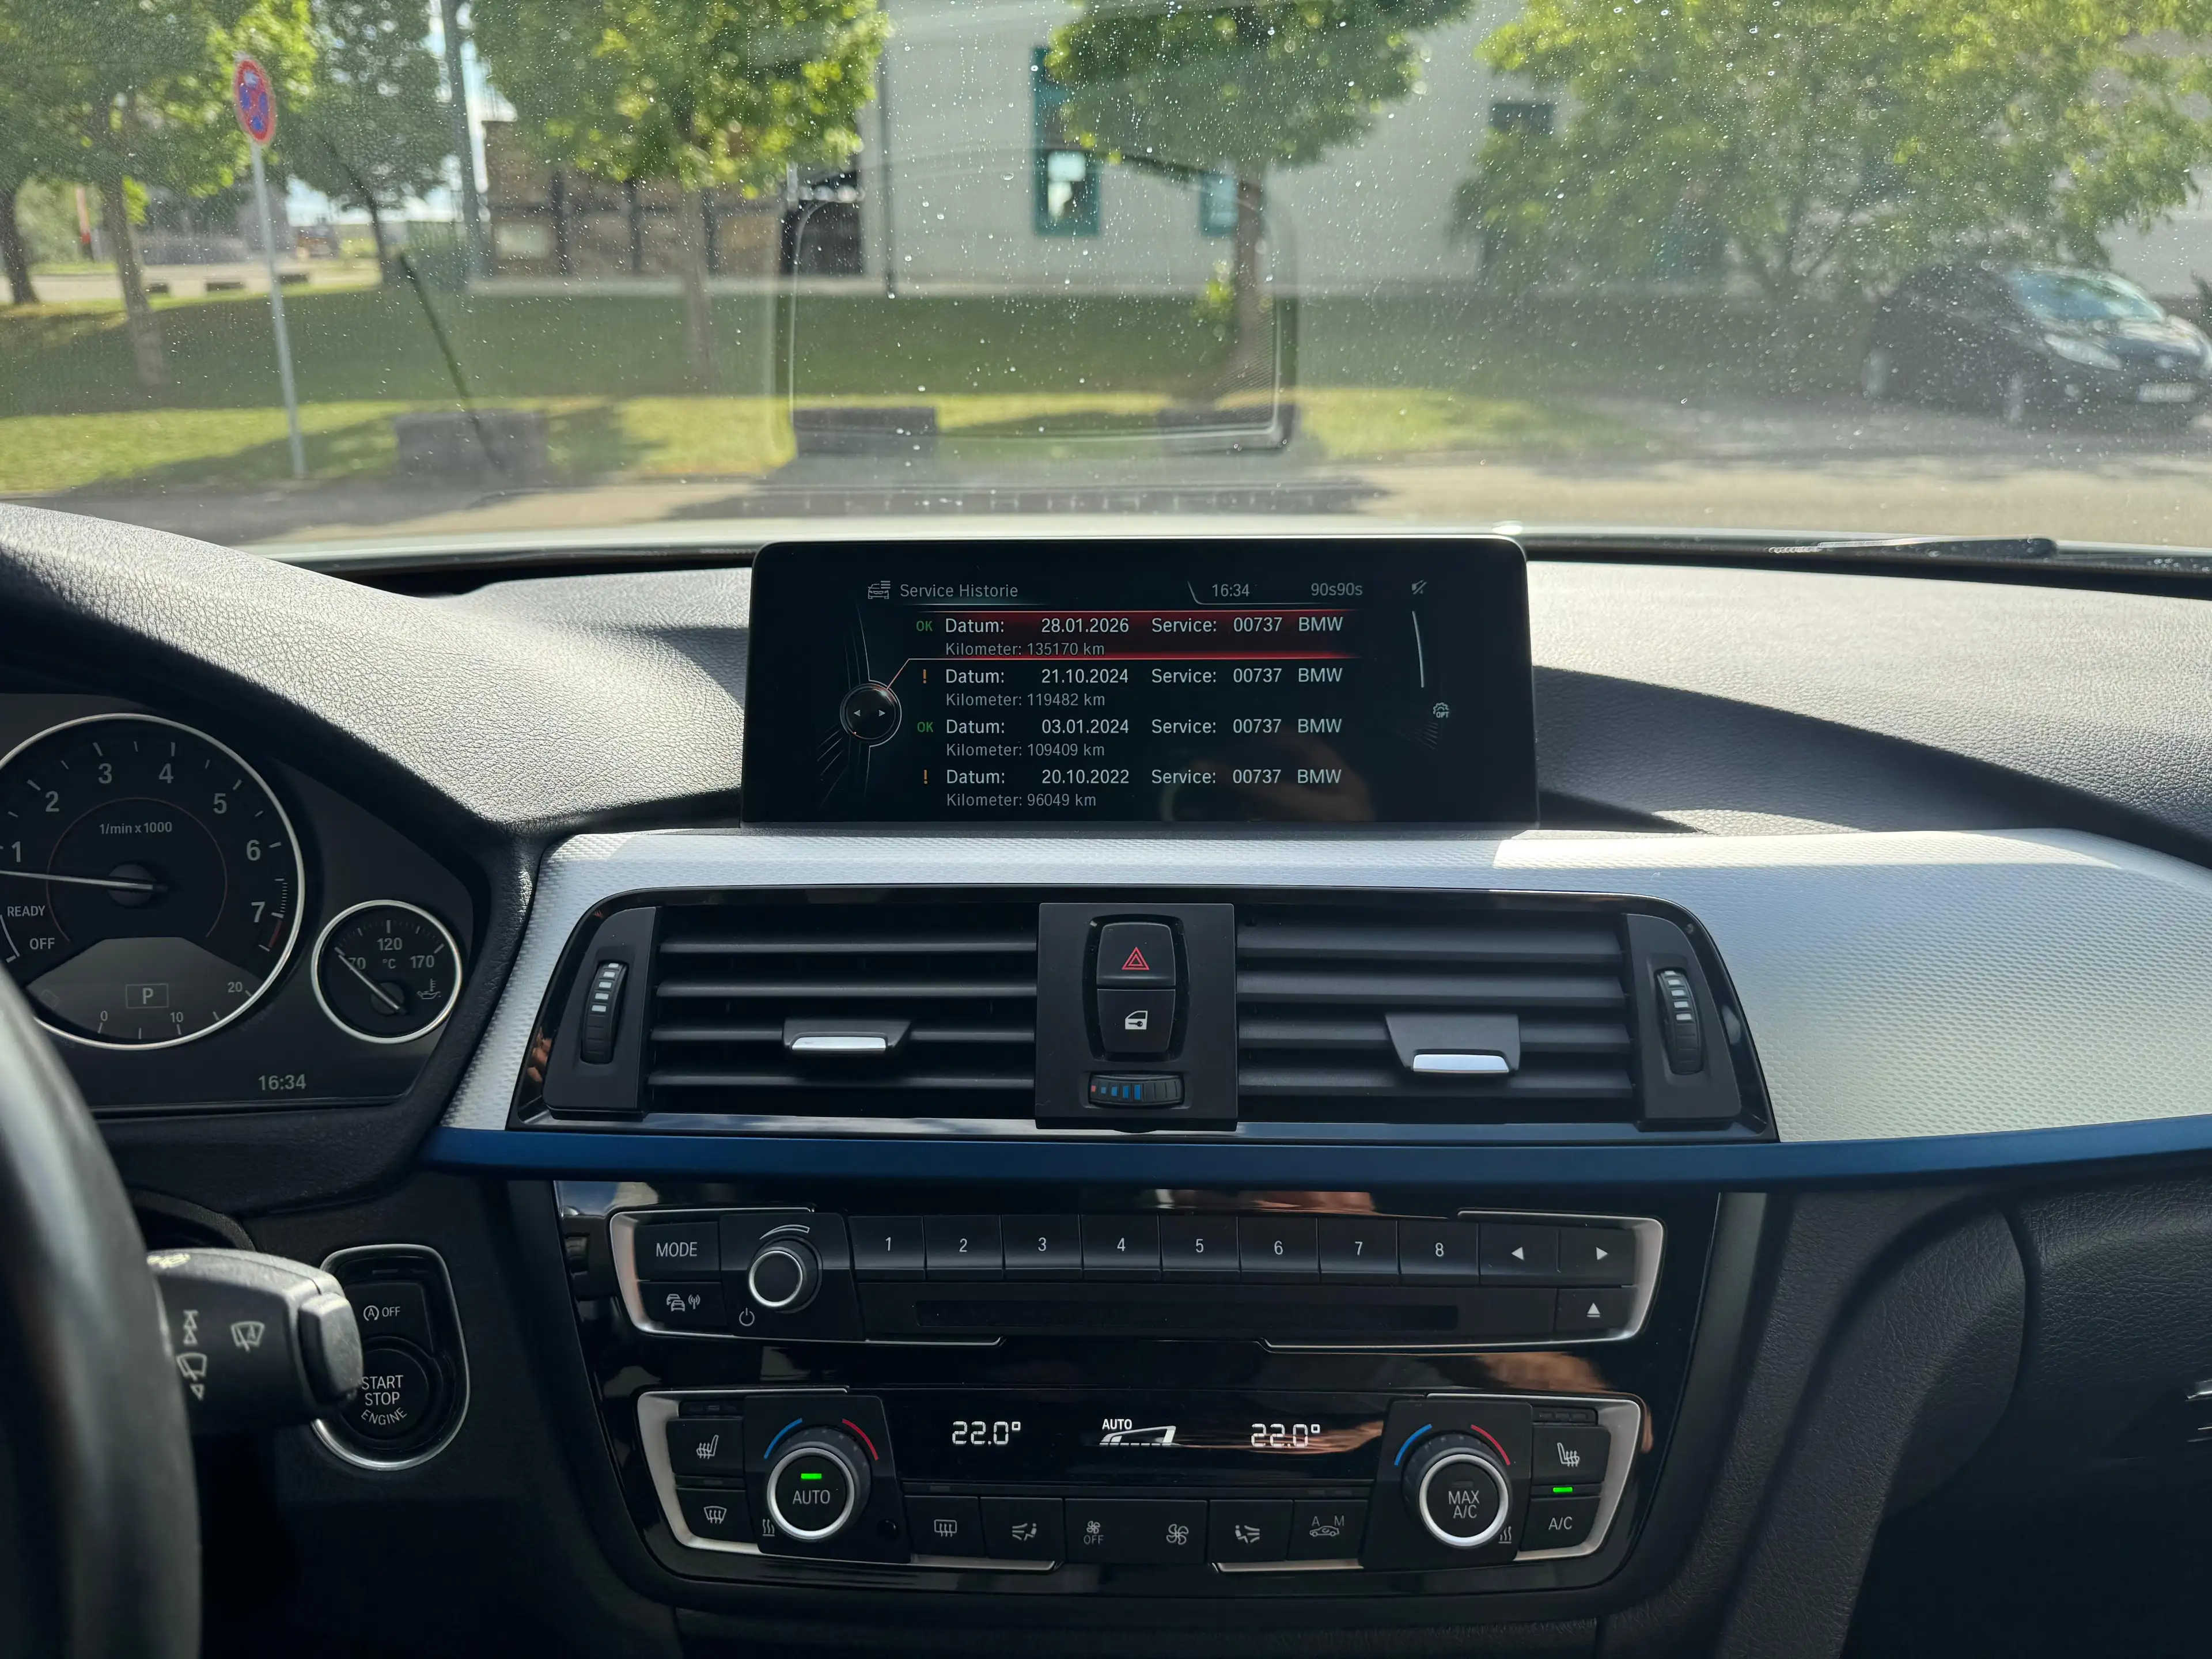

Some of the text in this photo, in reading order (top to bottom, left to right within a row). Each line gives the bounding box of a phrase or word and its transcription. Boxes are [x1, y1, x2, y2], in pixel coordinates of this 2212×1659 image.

[900, 584, 1018, 597] Service Historie
[1212, 584, 1250, 597] 16:34
[1310, 582, 1363, 596] 90s90s
[916, 617, 1343, 632] OK Datum: 28.01.2026 Service: 00737 BMW
[946, 642, 1104, 656] Kilometer: 135170 km
[946, 668, 1005, 683] Datum:
[1041, 668, 1129, 683] 21.10.2024
[1152, 668, 1217, 683] Service:
[1233, 668, 1283, 683] 00737
[1298, 668, 1343, 683] BMW
[946, 693, 1105, 706] Kilometer: 119482 km
[917, 718, 1343, 734] OK Datum: 03.01.2024 Service: 00737 BMW
[946, 743, 1105, 756] Kilometer: 109409 km
[98, 763, 112, 784] 3
[158, 763, 174, 784] 4
[946, 769, 1005, 784] Datum:
[1041, 769, 1129, 784] 20.10.2022
[1152, 768, 1217, 784] Service:
[1233, 768, 1283, 783] 00737
[1298, 768, 1343, 783] BMW
[45, 790, 60, 812] 2
[213, 793, 228, 814] 5
[946, 793, 1096, 806] Kilometer: 96049 km
[99, 822, 132, 835] 1/min
[143, 821, 172, 833] 1000
[11, 841, 21, 863] 1
[246, 839, 261, 861] 6
[7, 905, 46, 917] READY
[251, 901, 266, 923] 7
[29, 937, 55, 950] OFF
[377, 937, 403, 951] 120
[382, 959, 396, 969] °C
[410, 955, 435, 969] 170
[228, 981, 243, 993] 20
[142, 987, 153, 1004] P
[100, 1010, 108, 1021] 0
[170, 1012, 184, 1023] 10
[258, 1074, 306, 1090] 16:34
[656, 1241, 698, 1257] MODE
[885, 1237, 891, 1251] 1
[959, 1238, 968, 1252] 2
[1037, 1237, 1047, 1252] 3
[1117, 1237, 1126, 1252] 4
[1195, 1238, 1204, 1253] 5
[1274, 1240, 1283, 1255] 6
[1354, 1241, 1363, 1256] 7
[1435, 1242, 1444, 1257] 8
[381, 1306, 400, 1317] OFF
[361, 1374, 404, 1390] START
[365, 1391, 400, 1406] STOP
[361, 1407, 407, 1425] ENGINE
[1102, 1418, 1132, 1430] AUTO
[952, 1421, 1021, 1446] 22.0°
[1251, 1423, 1320, 1448] 22.0°
[792, 1489, 831, 1505] AUTO
[1448, 1490, 1480, 1505] MAX
[1453, 1504, 1477, 1519] A/C
[1548, 1516, 1573, 1530] A/C
[1083, 1532, 1104, 1545] OFF
